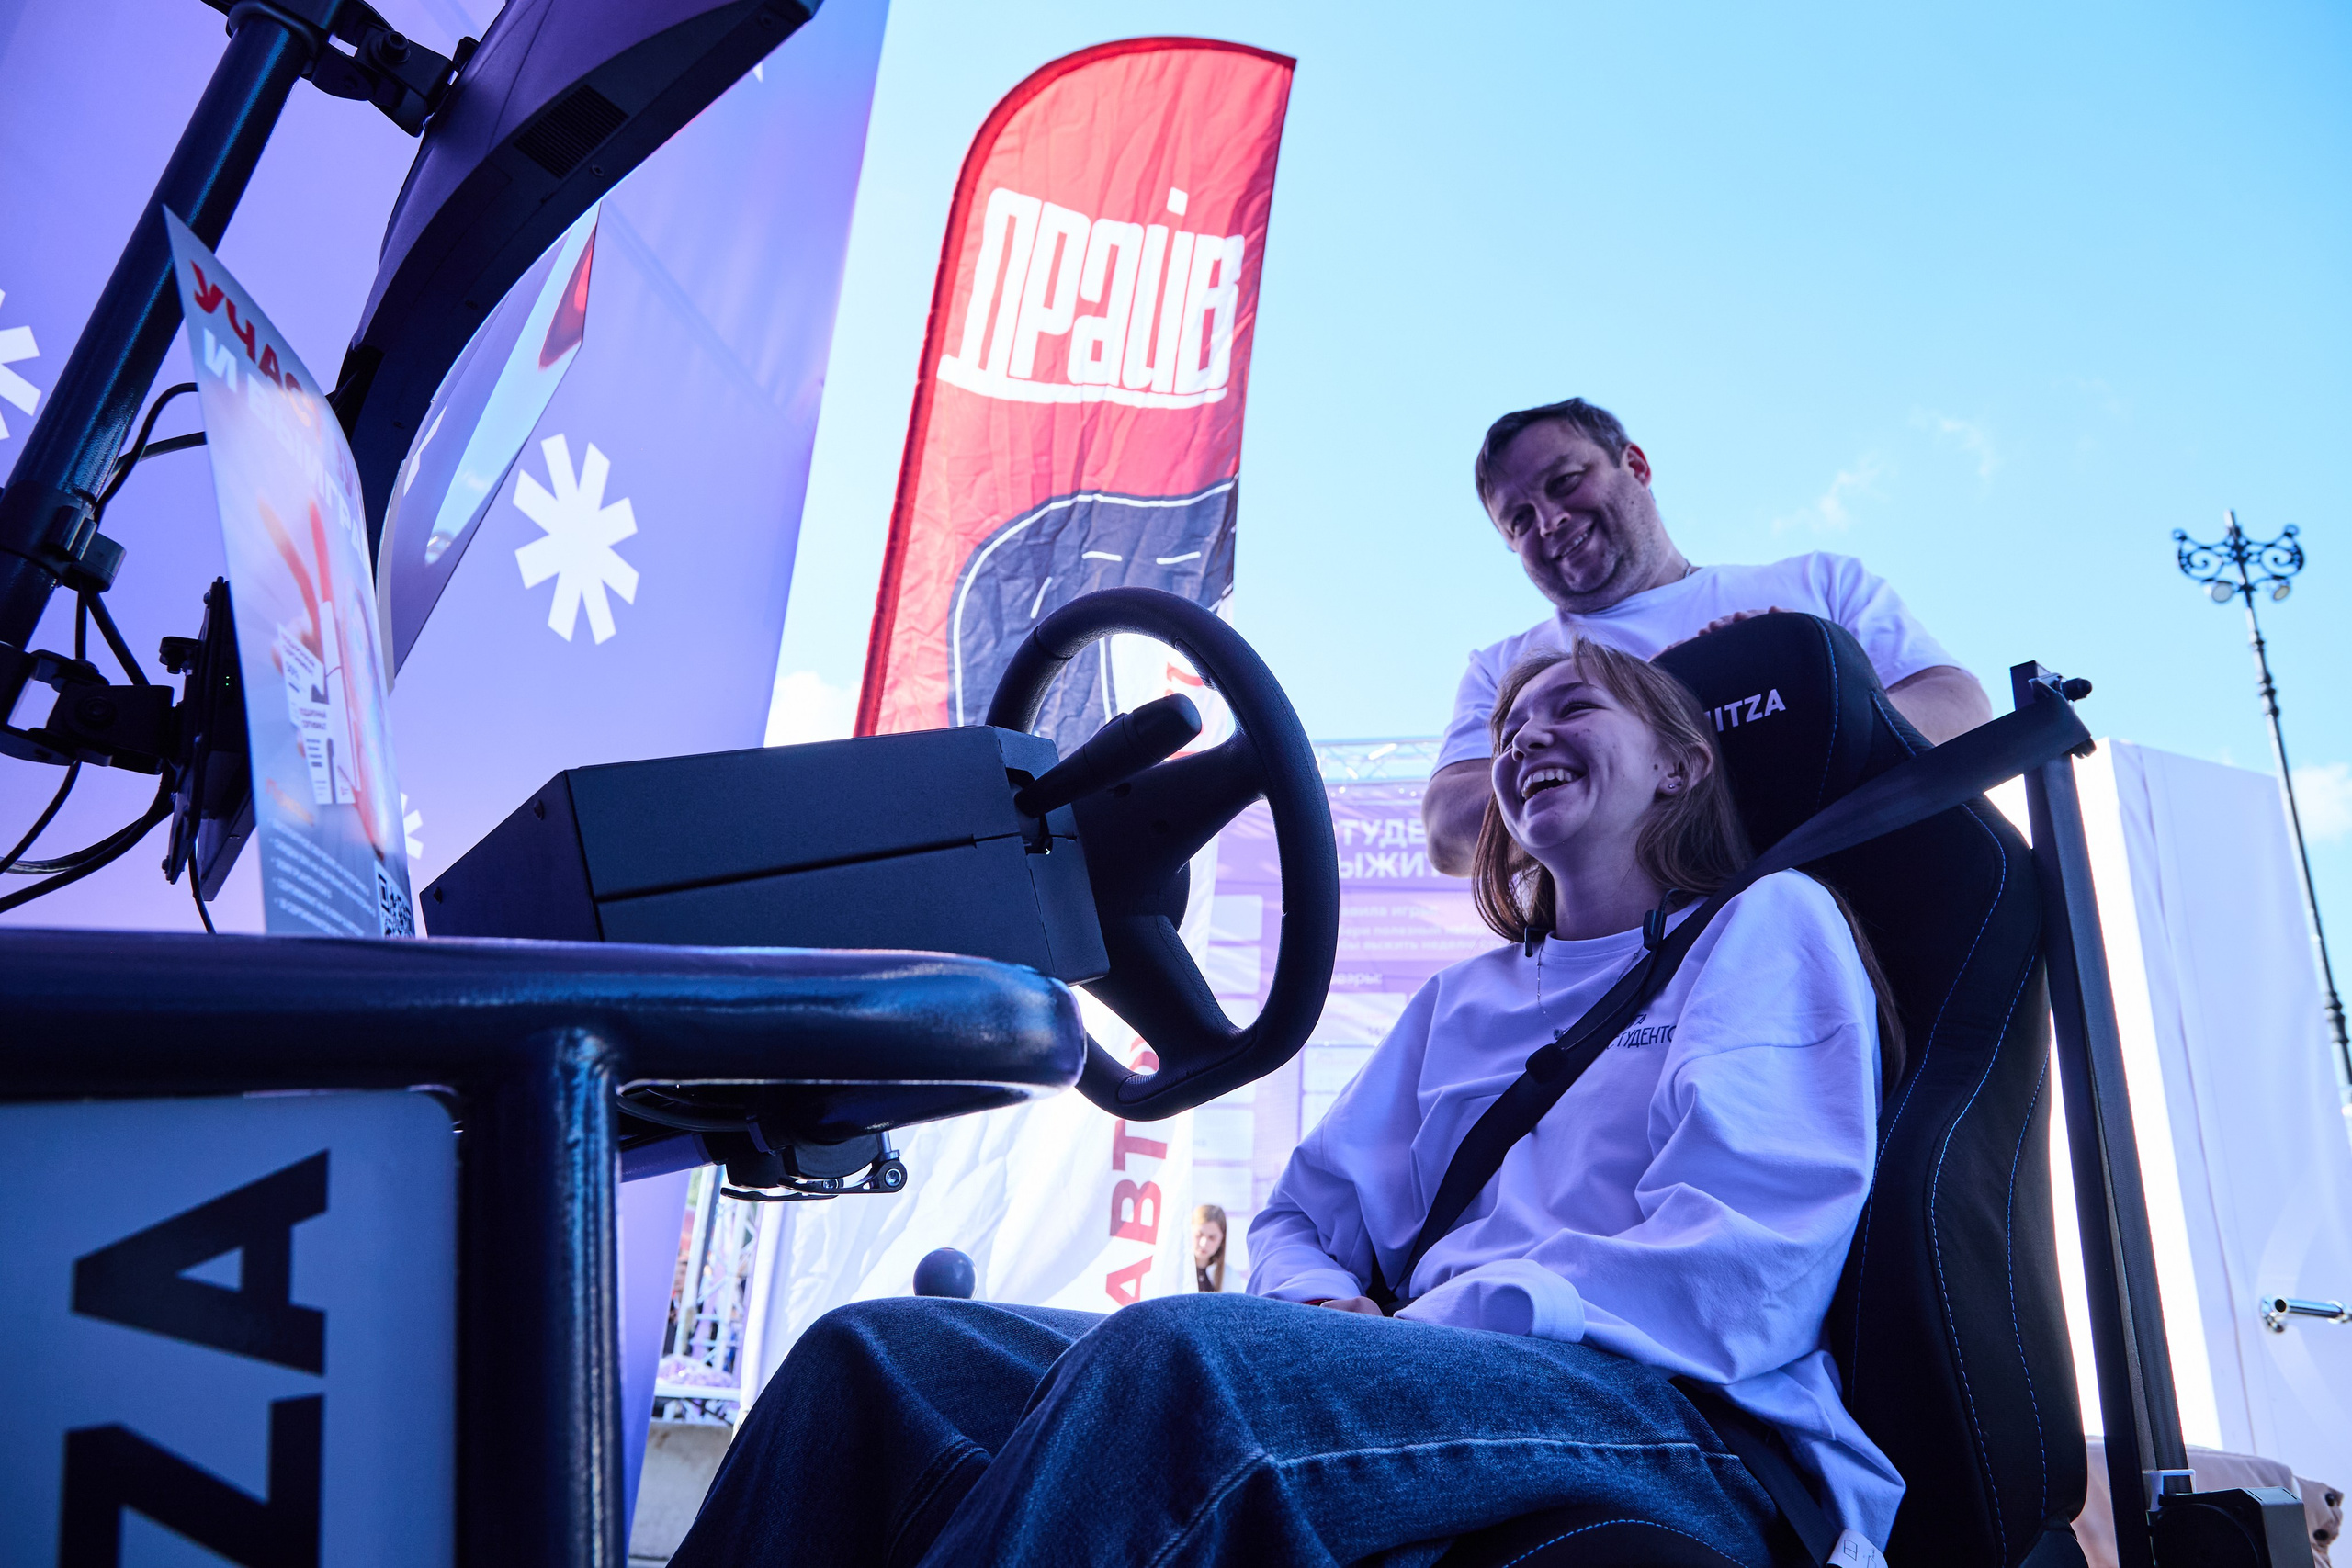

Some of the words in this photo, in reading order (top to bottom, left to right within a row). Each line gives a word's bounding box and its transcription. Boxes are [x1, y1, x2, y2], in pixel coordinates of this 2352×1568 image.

[203, 327, 239, 394] И
[1703, 688, 1787, 733] ITZA
[1338, 818, 1427, 850] ТУДЕ
[1338, 851, 1441, 879] ЫЖИ
